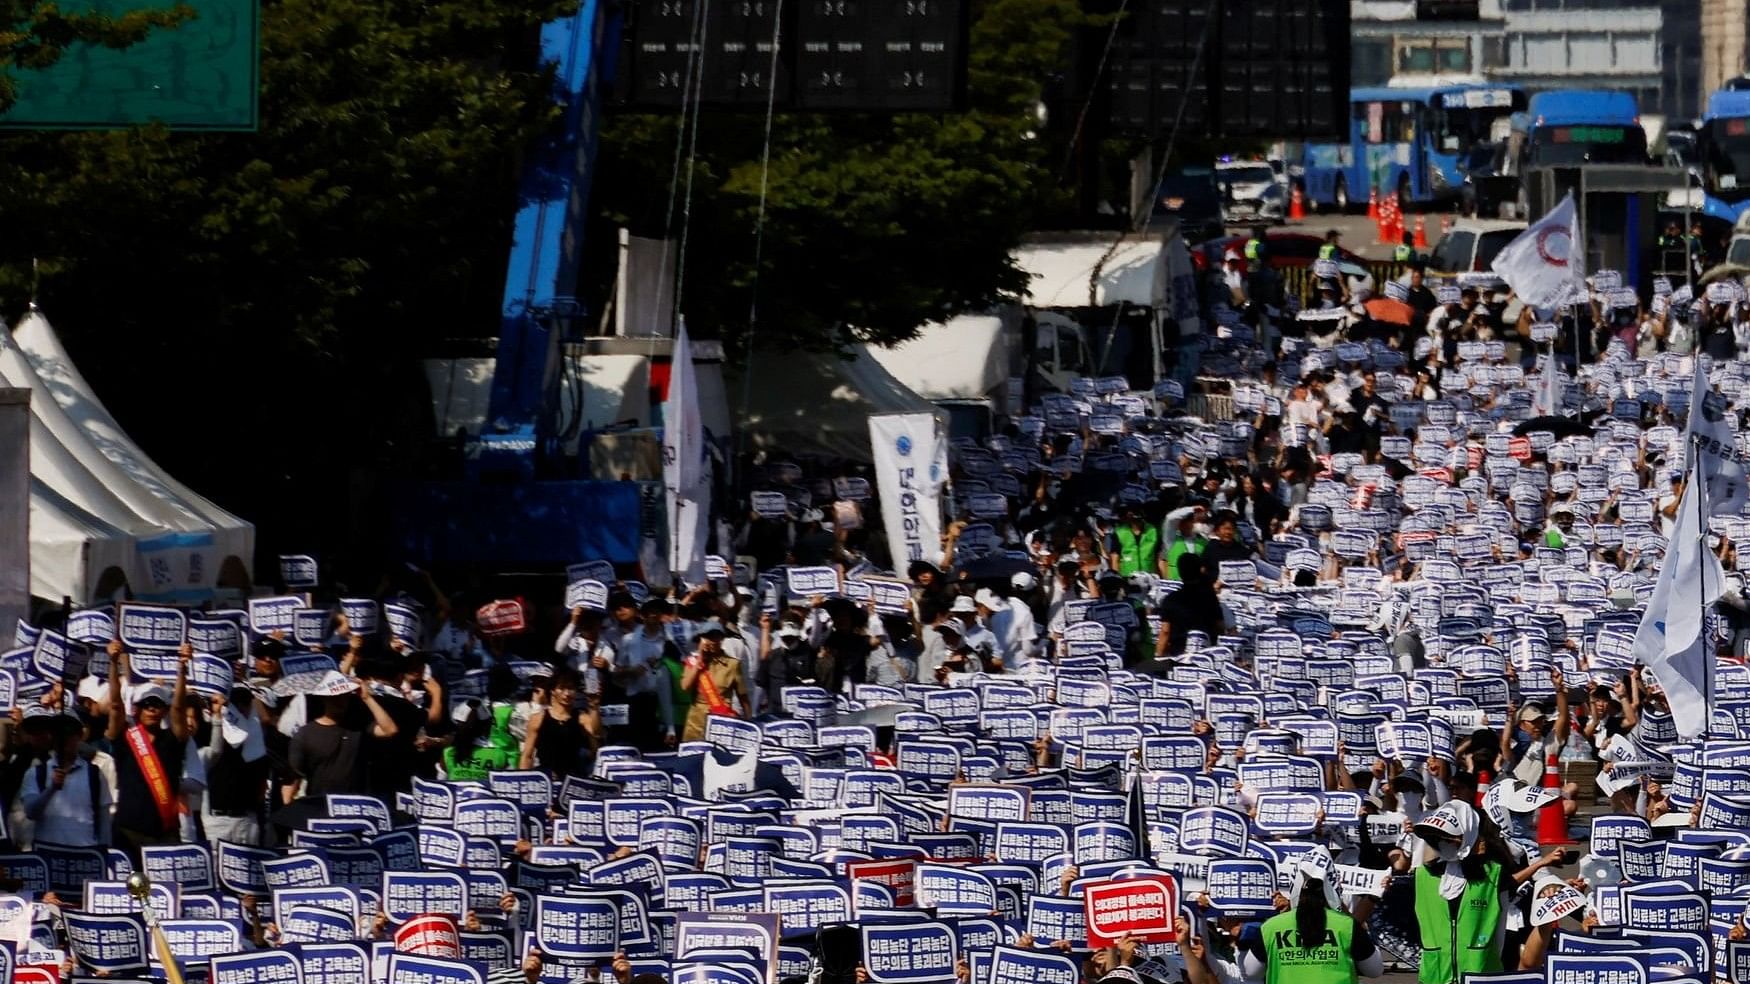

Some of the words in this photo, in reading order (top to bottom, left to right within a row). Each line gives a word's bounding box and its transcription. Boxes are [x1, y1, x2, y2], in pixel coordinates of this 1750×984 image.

[542, 912, 577, 928] 의료농단
[580, 913, 614, 927] 교육농단
[1631, 909, 1666, 923] 의료농단
[1669, 908, 1703, 923] 교육농단
[869, 937, 911, 953] 의료농단
[913, 935, 951, 952] 교육농단
[871, 955, 911, 972] 필수의료
[913, 953, 951, 968] 붕괴된다
[1037, 964, 1073, 982] 교육농단
